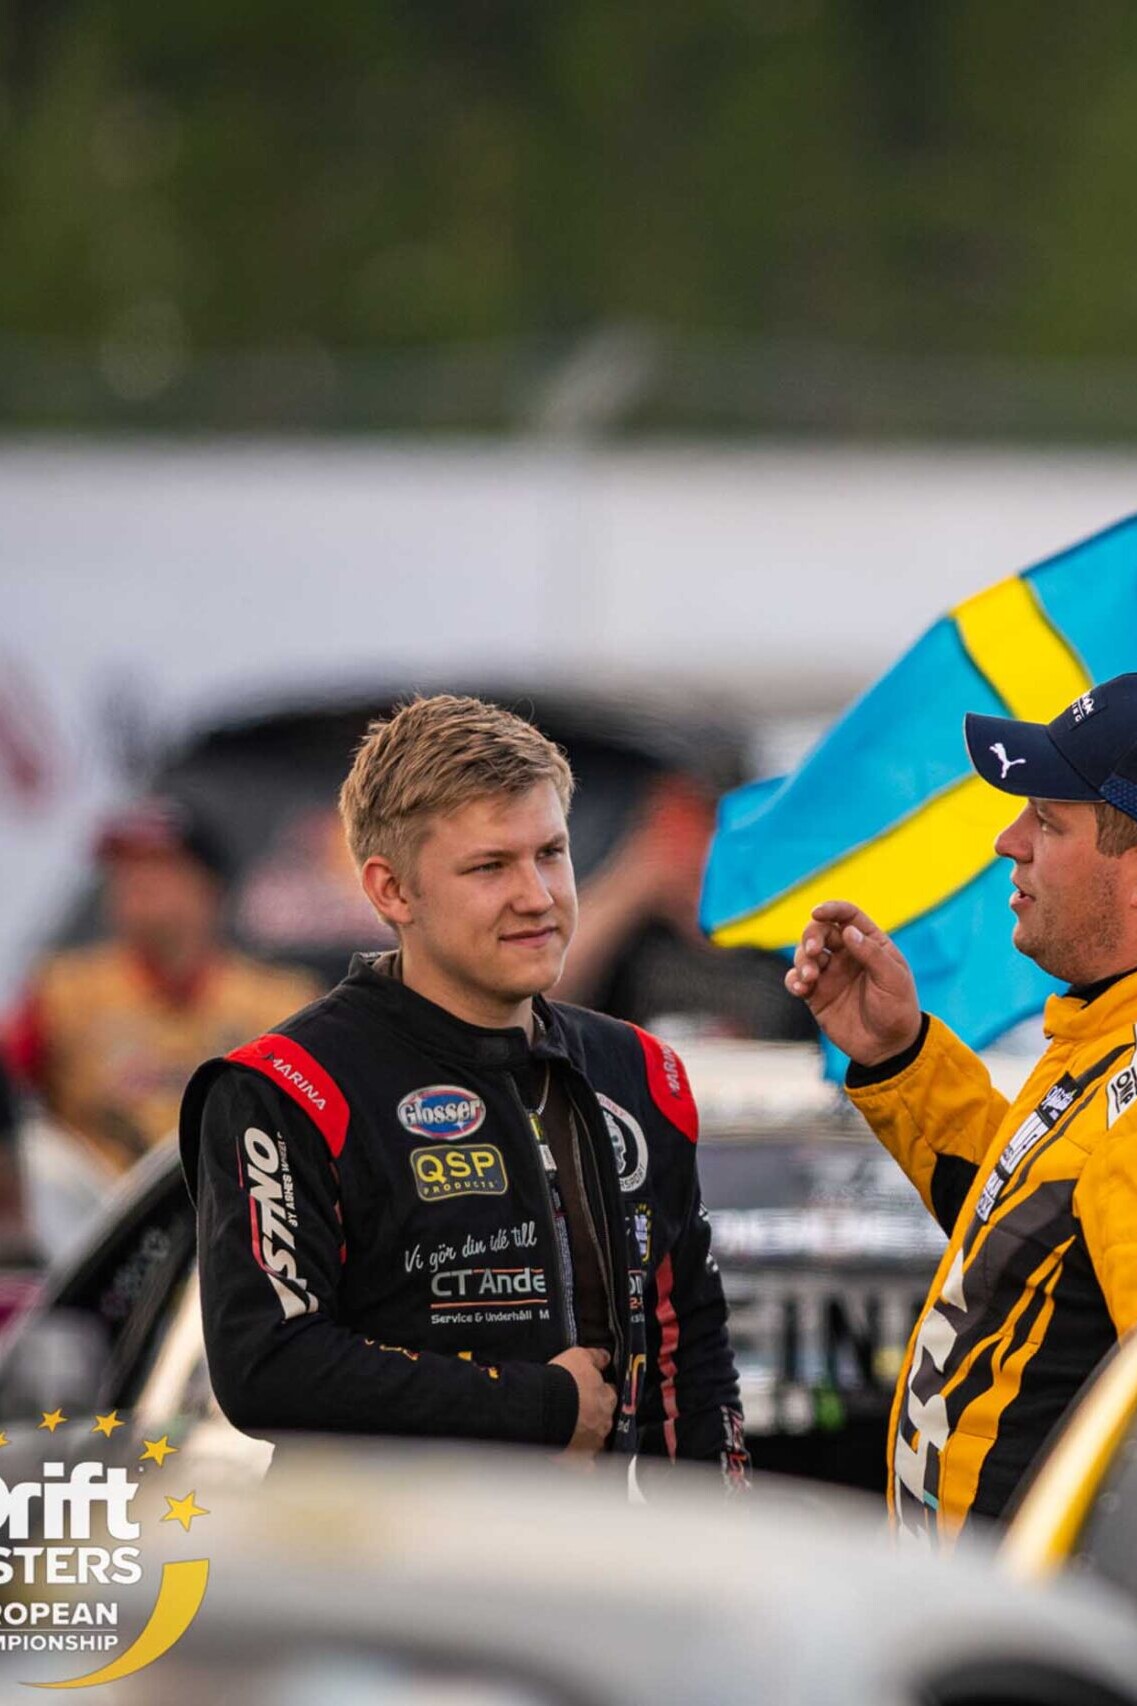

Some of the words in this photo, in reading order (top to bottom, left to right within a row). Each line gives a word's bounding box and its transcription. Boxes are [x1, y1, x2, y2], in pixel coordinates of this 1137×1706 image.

[272, 1058, 327, 1111] MARINA
[399, 1098, 481, 1126] Glosser
[416, 1151, 496, 1184] QSP
[423, 1180, 495, 1195] PRODUCTS
[404, 1244, 424, 1273] Vi
[429, 1243, 457, 1273] gör
[462, 1234, 487, 1258] din
[490, 1228, 510, 1252] idé
[511, 1220, 538, 1248] till
[431, 1269, 473, 1297] CT
[478, 1267, 547, 1295] Ande
[430, 1312, 473, 1325] Service
[474, 1312, 484, 1323] &
